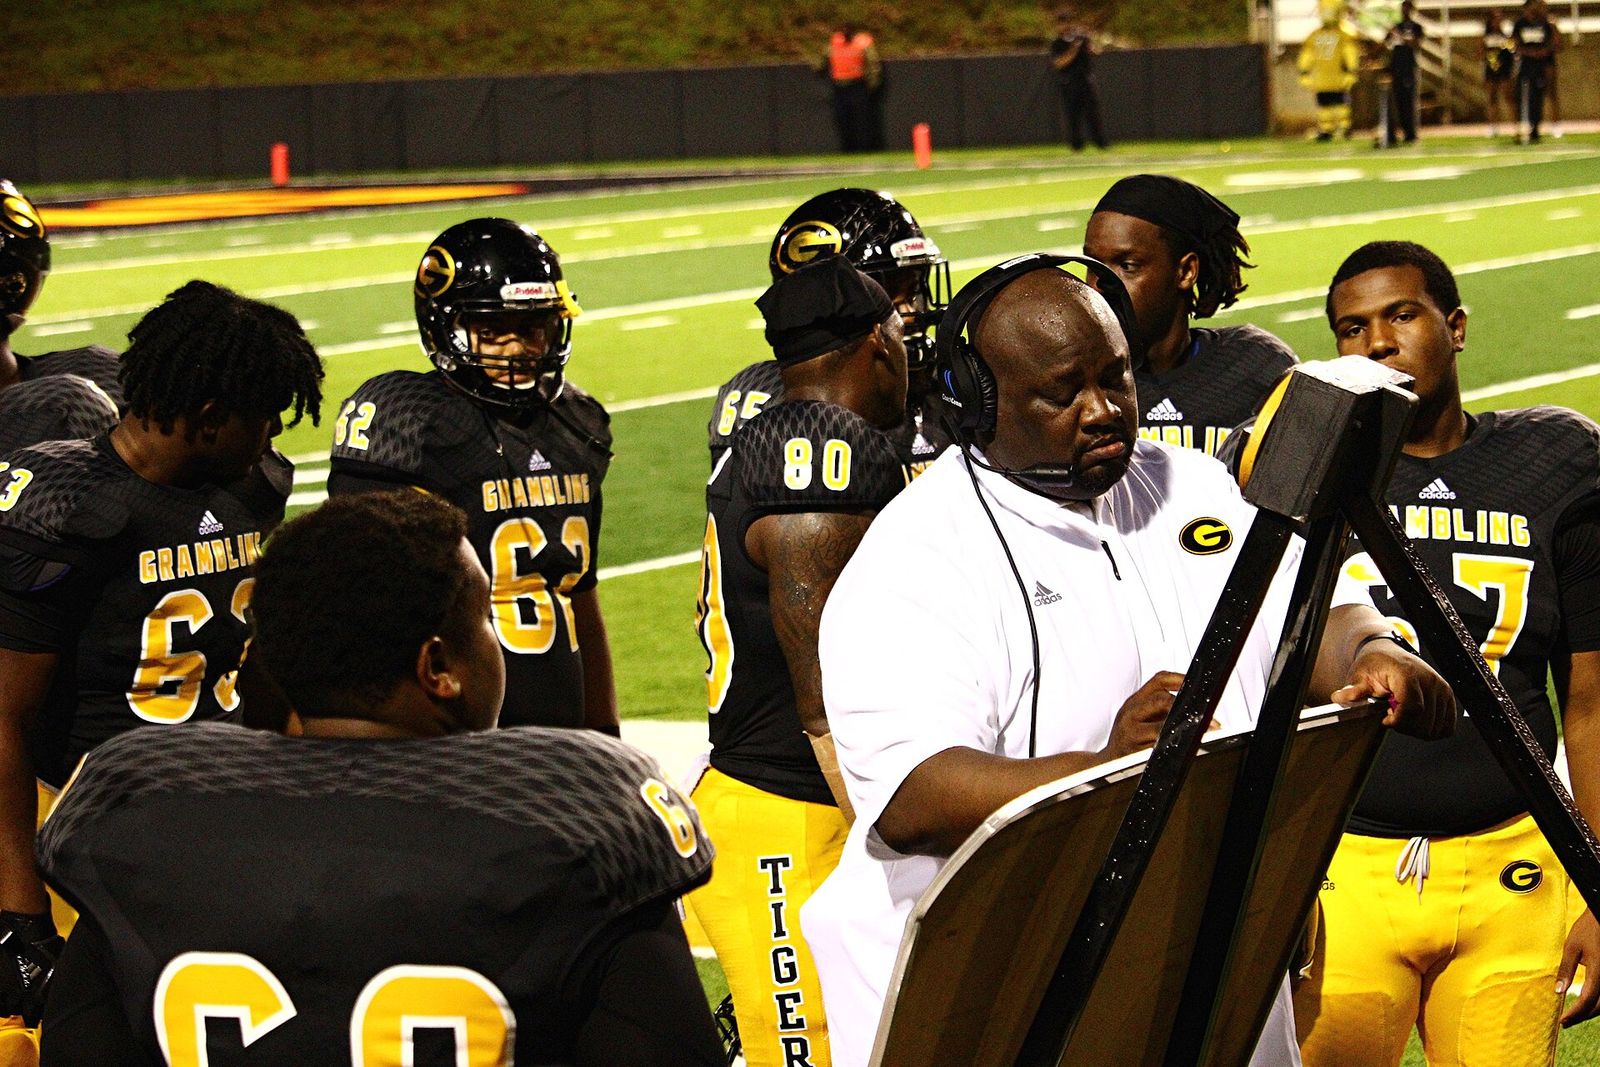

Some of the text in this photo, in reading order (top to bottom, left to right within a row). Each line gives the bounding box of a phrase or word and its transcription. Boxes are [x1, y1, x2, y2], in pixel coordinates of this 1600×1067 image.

[416, 246, 456, 299] G
[515, 287, 543, 295] Riddell
[1146, 411, 1183, 421] adidas
[784, 438, 852, 491] 80
[0, 461, 34, 511] 3
[482, 473, 590, 512] GRAMBLING
[1418, 490, 1456, 500] adidas
[199, 523, 223, 535] adidas
[1179, 517, 1233, 555] G
[490, 516, 590, 654] 62
[1033, 594, 1062, 607] adidas
[1500, 859, 1543, 894] G
